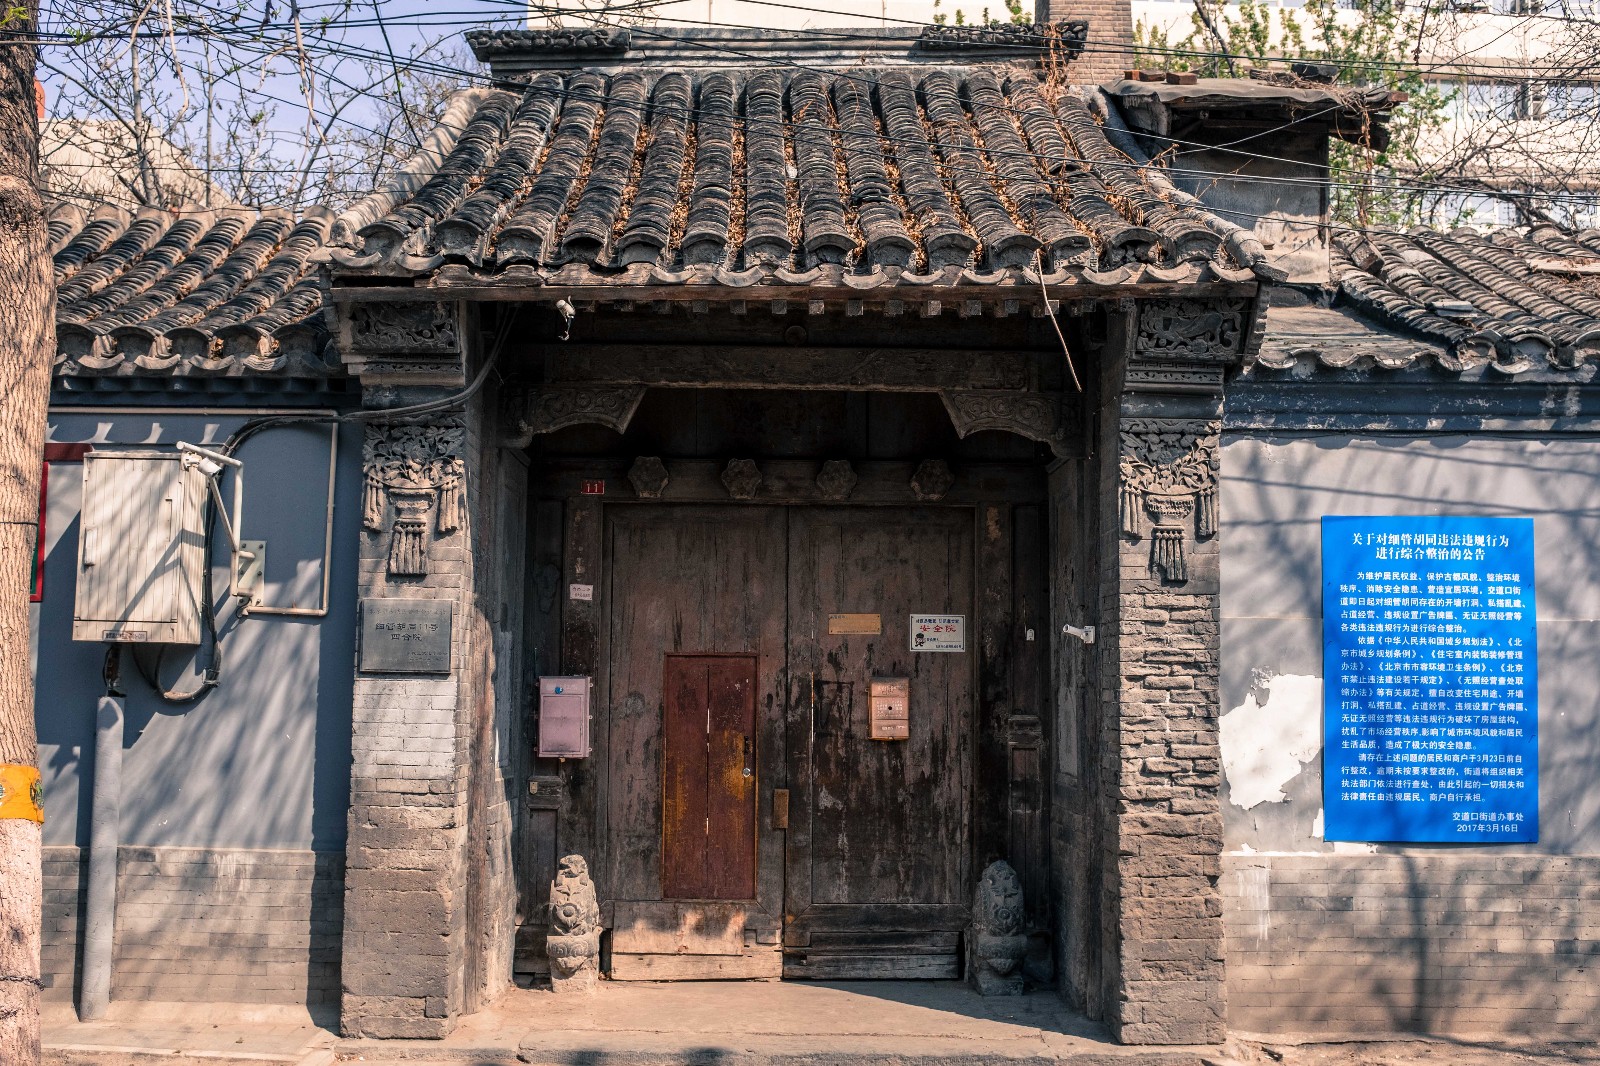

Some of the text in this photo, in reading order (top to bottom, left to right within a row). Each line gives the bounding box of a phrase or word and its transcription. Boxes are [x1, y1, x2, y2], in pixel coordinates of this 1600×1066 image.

[1352, 533, 1510, 547] 关于对细管胡同违法违规行为
[1375, 547, 1486, 561] 进行综合整治的公告
[1356, 571, 1521, 583] 为维护居民权益、保护古都风貌、整治环境
[919, 624, 957, 633] 安全院
[1340, 622, 1467, 634] 各类违法违规行为进行综合整治。
[390, 633, 422, 641] 四合院
[1357, 635, 1523, 647] 依据《中华人民共和国城乡规划法》、《北
[1358, 752, 1523, 764] 请存在上述问题的居民和商户于3月23日前自
[1340, 791, 1486, 802] 法律责任由违规居民、商户自行承担。
[1452, 811, 1524, 822] 交道口街道办事处
[1456, 823, 1518, 833] 2017年3月16日
